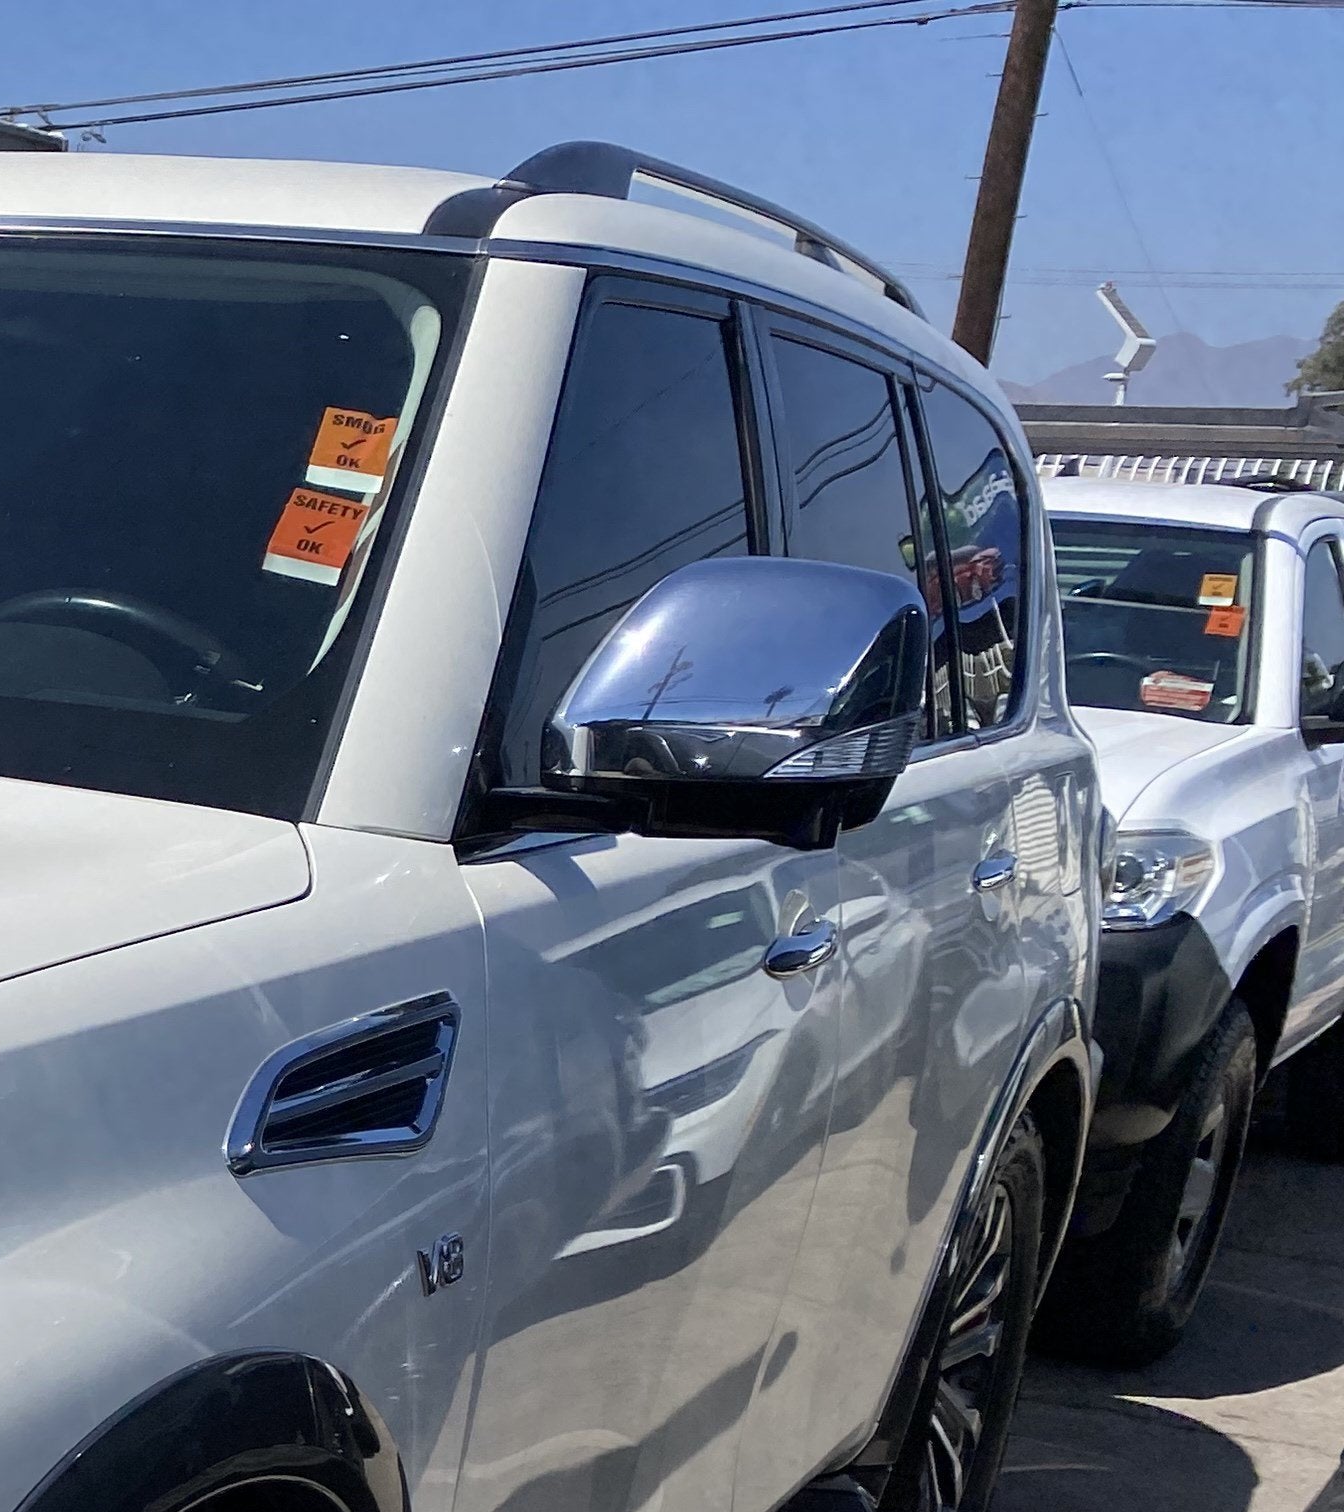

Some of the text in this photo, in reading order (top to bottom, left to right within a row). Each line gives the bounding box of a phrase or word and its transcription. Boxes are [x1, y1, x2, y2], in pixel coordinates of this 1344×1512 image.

[331, 414, 386, 435] SMOG
[336, 454, 360, 469] OK
[293, 494, 365, 520] SAFETY
[296, 538, 324, 554] OK
[417, 1232, 464, 1297] V8
